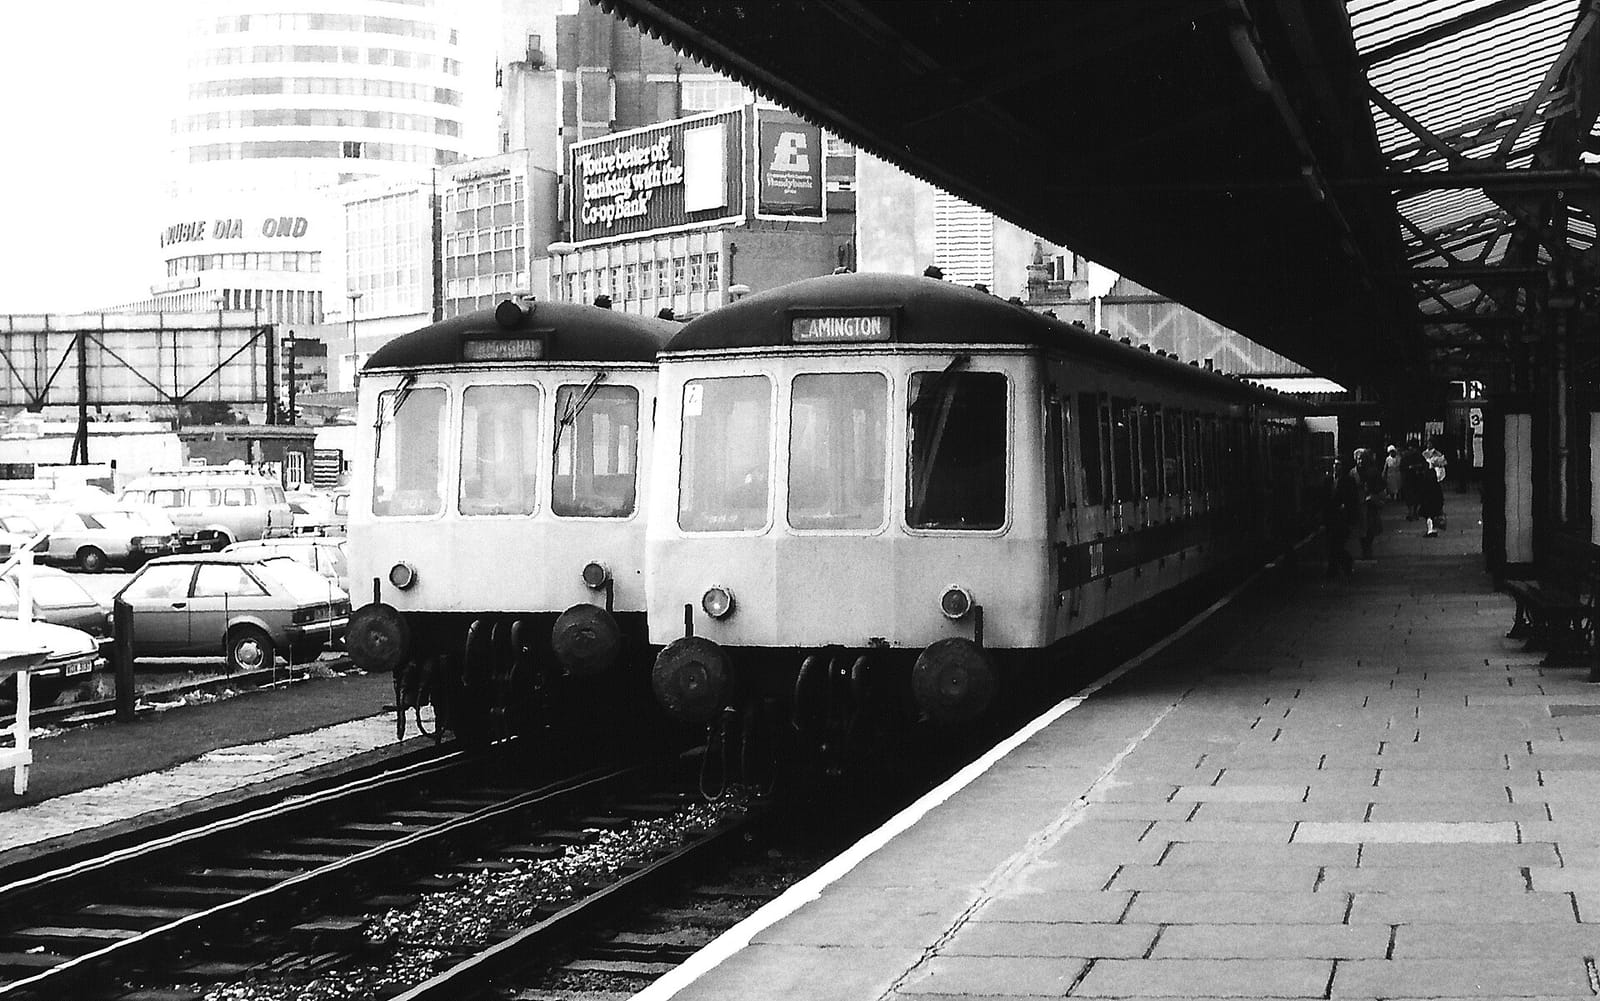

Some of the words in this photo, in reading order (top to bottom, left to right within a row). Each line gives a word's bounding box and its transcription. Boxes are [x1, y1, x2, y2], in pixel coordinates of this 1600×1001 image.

[615, 145, 651, 170] better
[651, 134, 671, 163] off
[583, 172, 632, 201] banking
[632, 163, 661, 190] with
[662, 160, 683, 186] the
[582, 201, 615, 228] Co-op
[1471, 414, 1480, 425] 3
